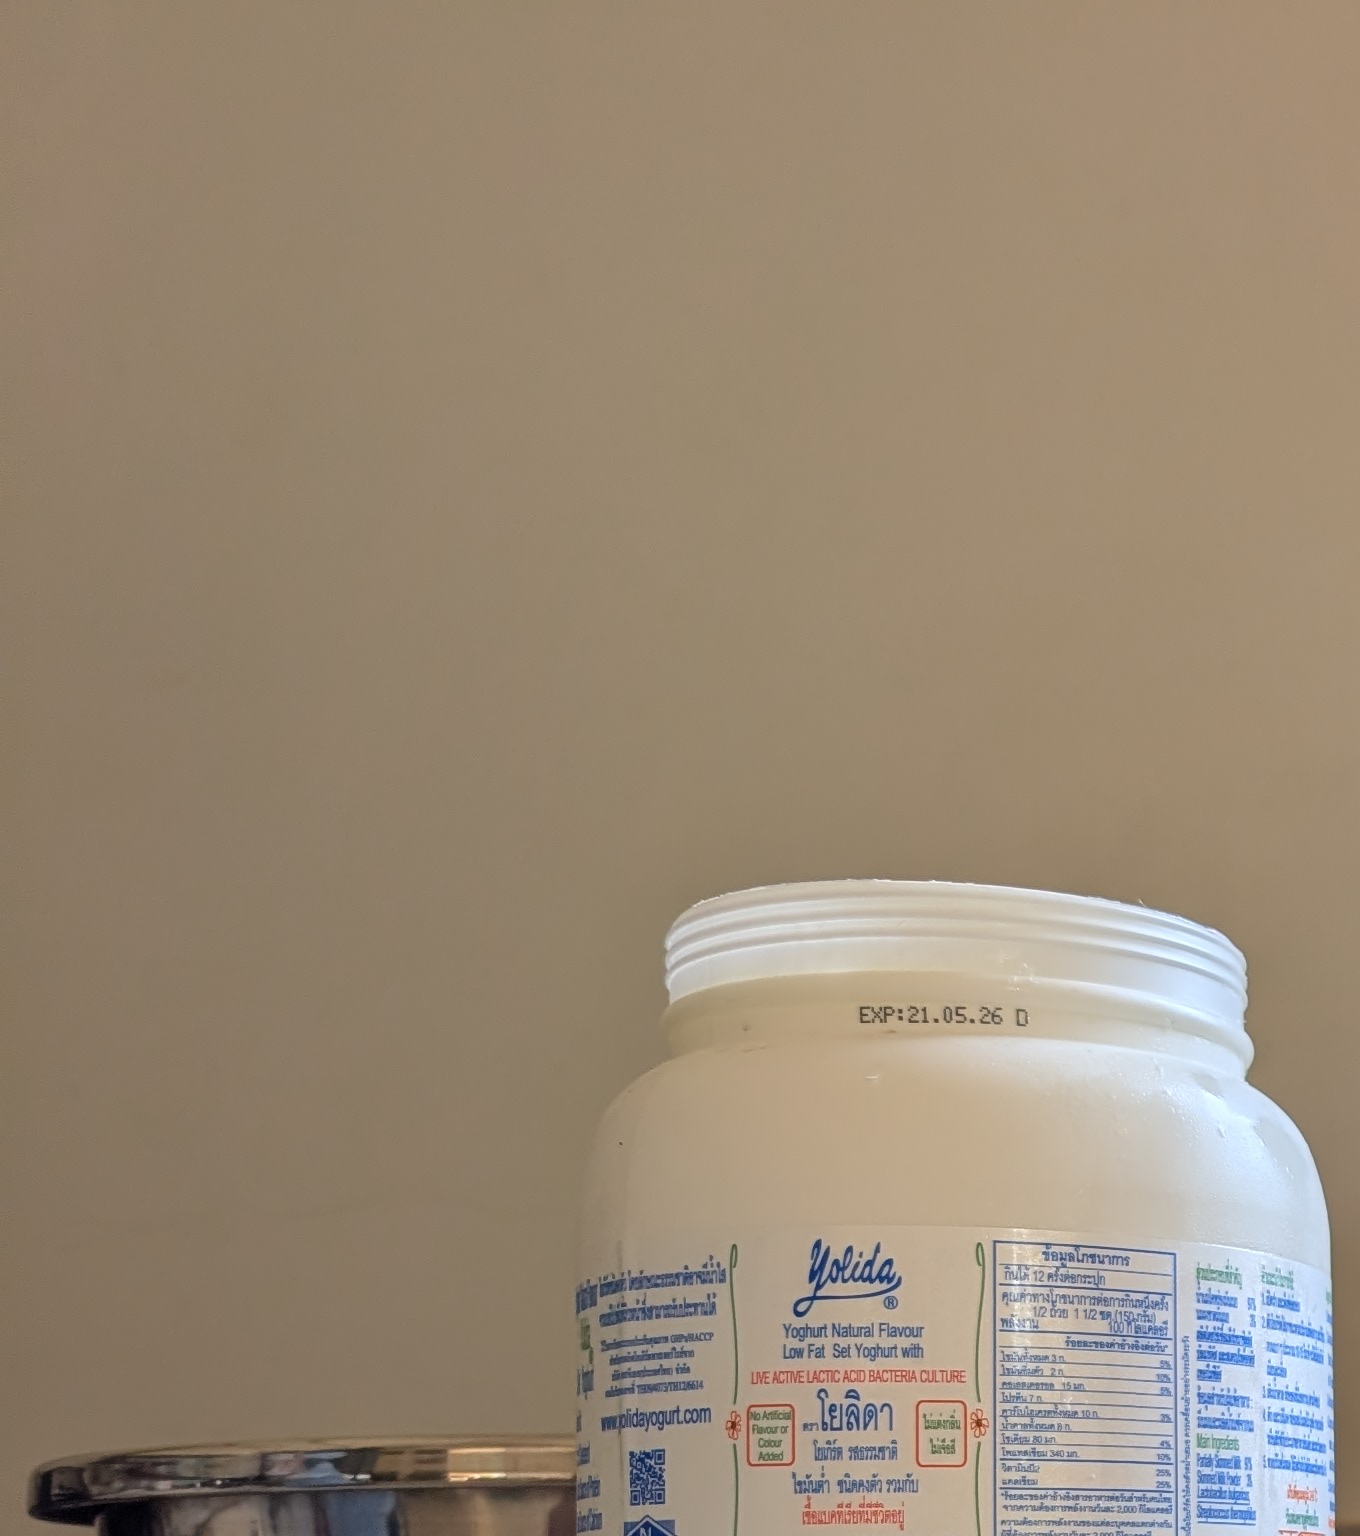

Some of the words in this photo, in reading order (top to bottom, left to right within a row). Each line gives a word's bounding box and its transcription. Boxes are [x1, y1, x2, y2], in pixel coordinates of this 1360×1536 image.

[859, 1006, 1003, 1025] EXP:21.05.26
[1042, 1244, 1131, 1268] ข้อมูลโภชนาการ
[793, 1238, 902, 1318] Yolida
[1004, 1266, 1030, 1282] กินได้
[1033, 1271, 1045, 1283] 12
[783, 1322, 828, 1342] Yoghurt
[832, 1322, 874, 1338] Natural
[879, 1322, 924, 1338] Flavour
[783, 1343, 805, 1360] Low
[807, 1343, 825, 1359] Fat
[833, 1343, 851, 1359] Set
[855, 1343, 898, 1362] Yoghurt
[901, 1343, 924, 1359] with
[751, 1371, 770, 1385] LIVE
[772, 1370, 805, 1385] ACTIVE
[806, 1370, 840, 1384] LACTIC
[842, 1370, 865, 1384] ACID
[868, 1369, 917, 1383] BACTERIA
[920, 1369, 966, 1383] CULTURE
[750, 1410, 761, 1421] No
[762, 1409, 792, 1421] Artificial
[817, 1387, 893, 1432] โยลิดา
[752, 1424, 779, 1435] Flavour
[781, 1426, 789, 1434] or
[758, 1437, 783, 1449] Colour
[758, 1451, 784, 1462] Added
